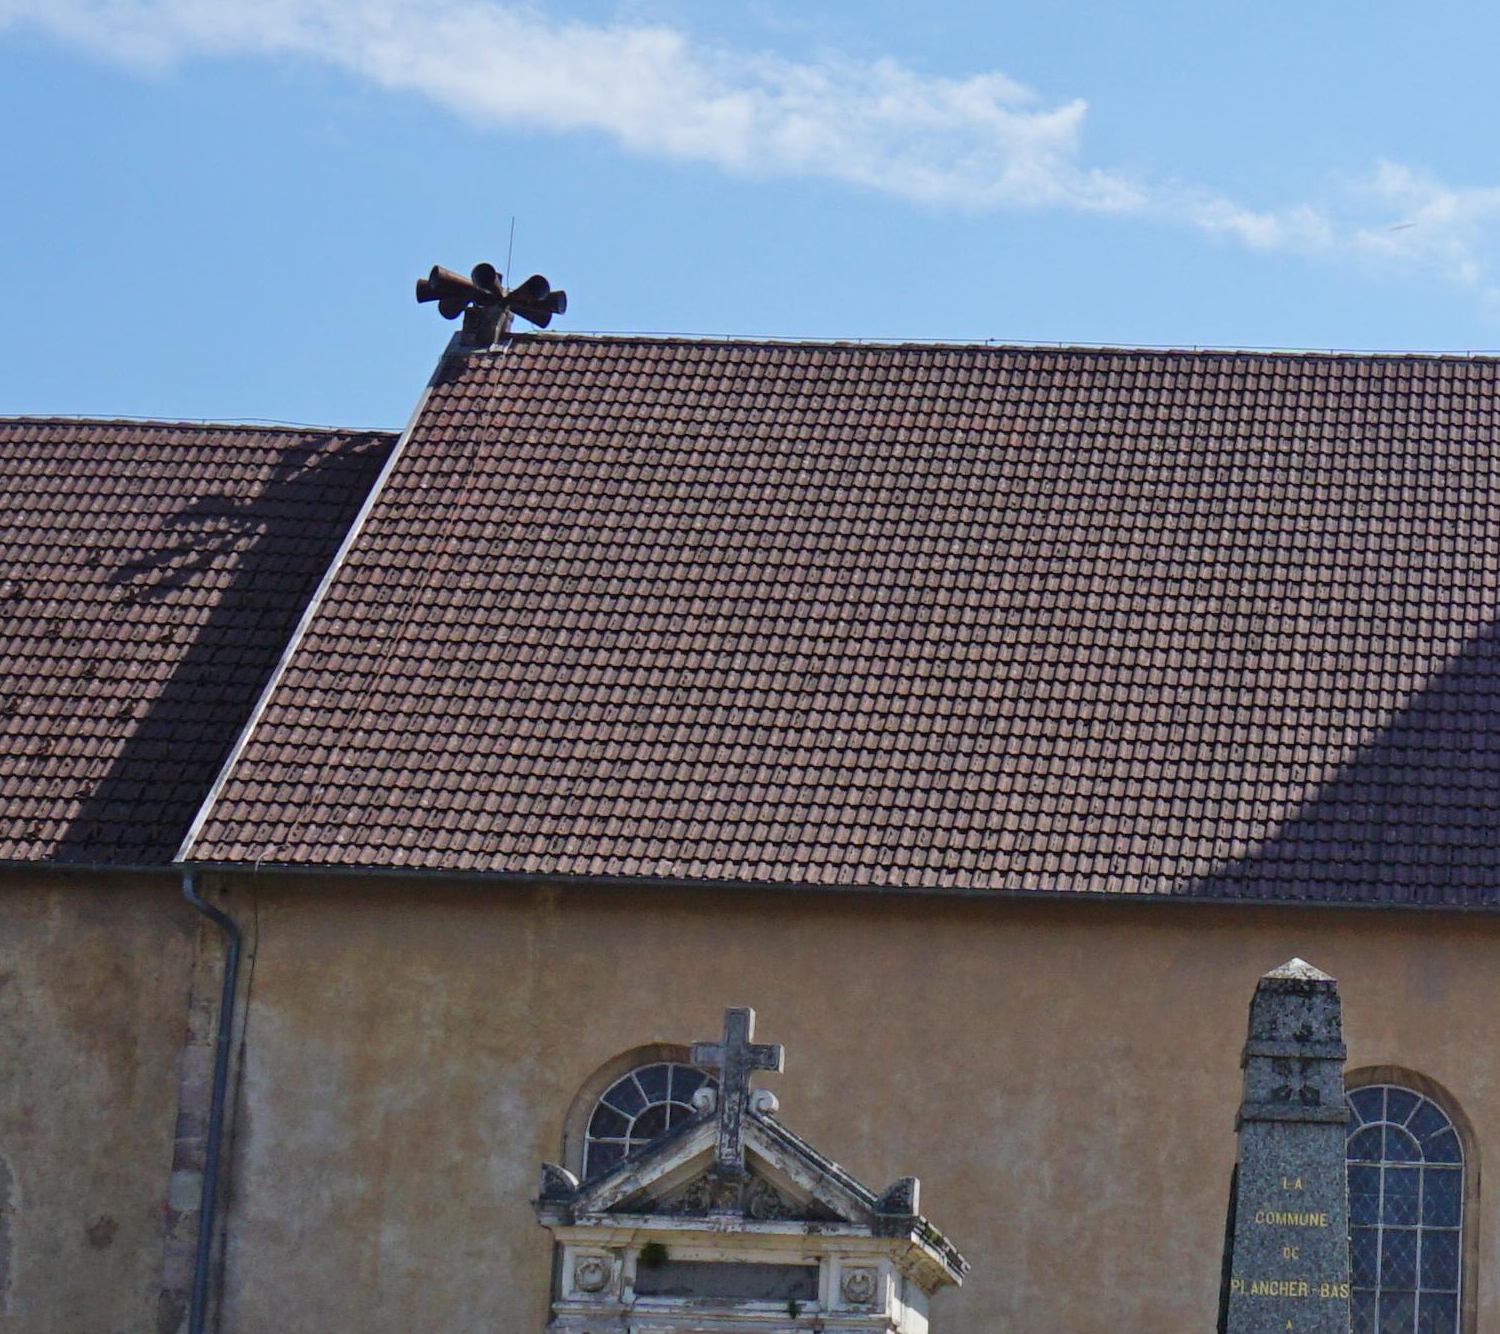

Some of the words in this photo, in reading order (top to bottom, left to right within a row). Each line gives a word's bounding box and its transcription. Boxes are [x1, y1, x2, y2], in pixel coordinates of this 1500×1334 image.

[1283, 1177, 1303, 1190] LA
[1255, 1211, 1329, 1227] COMMUNE
[1283, 1246, 1300, 1259] DE
[1285, 1320, 1293, 1330] A
